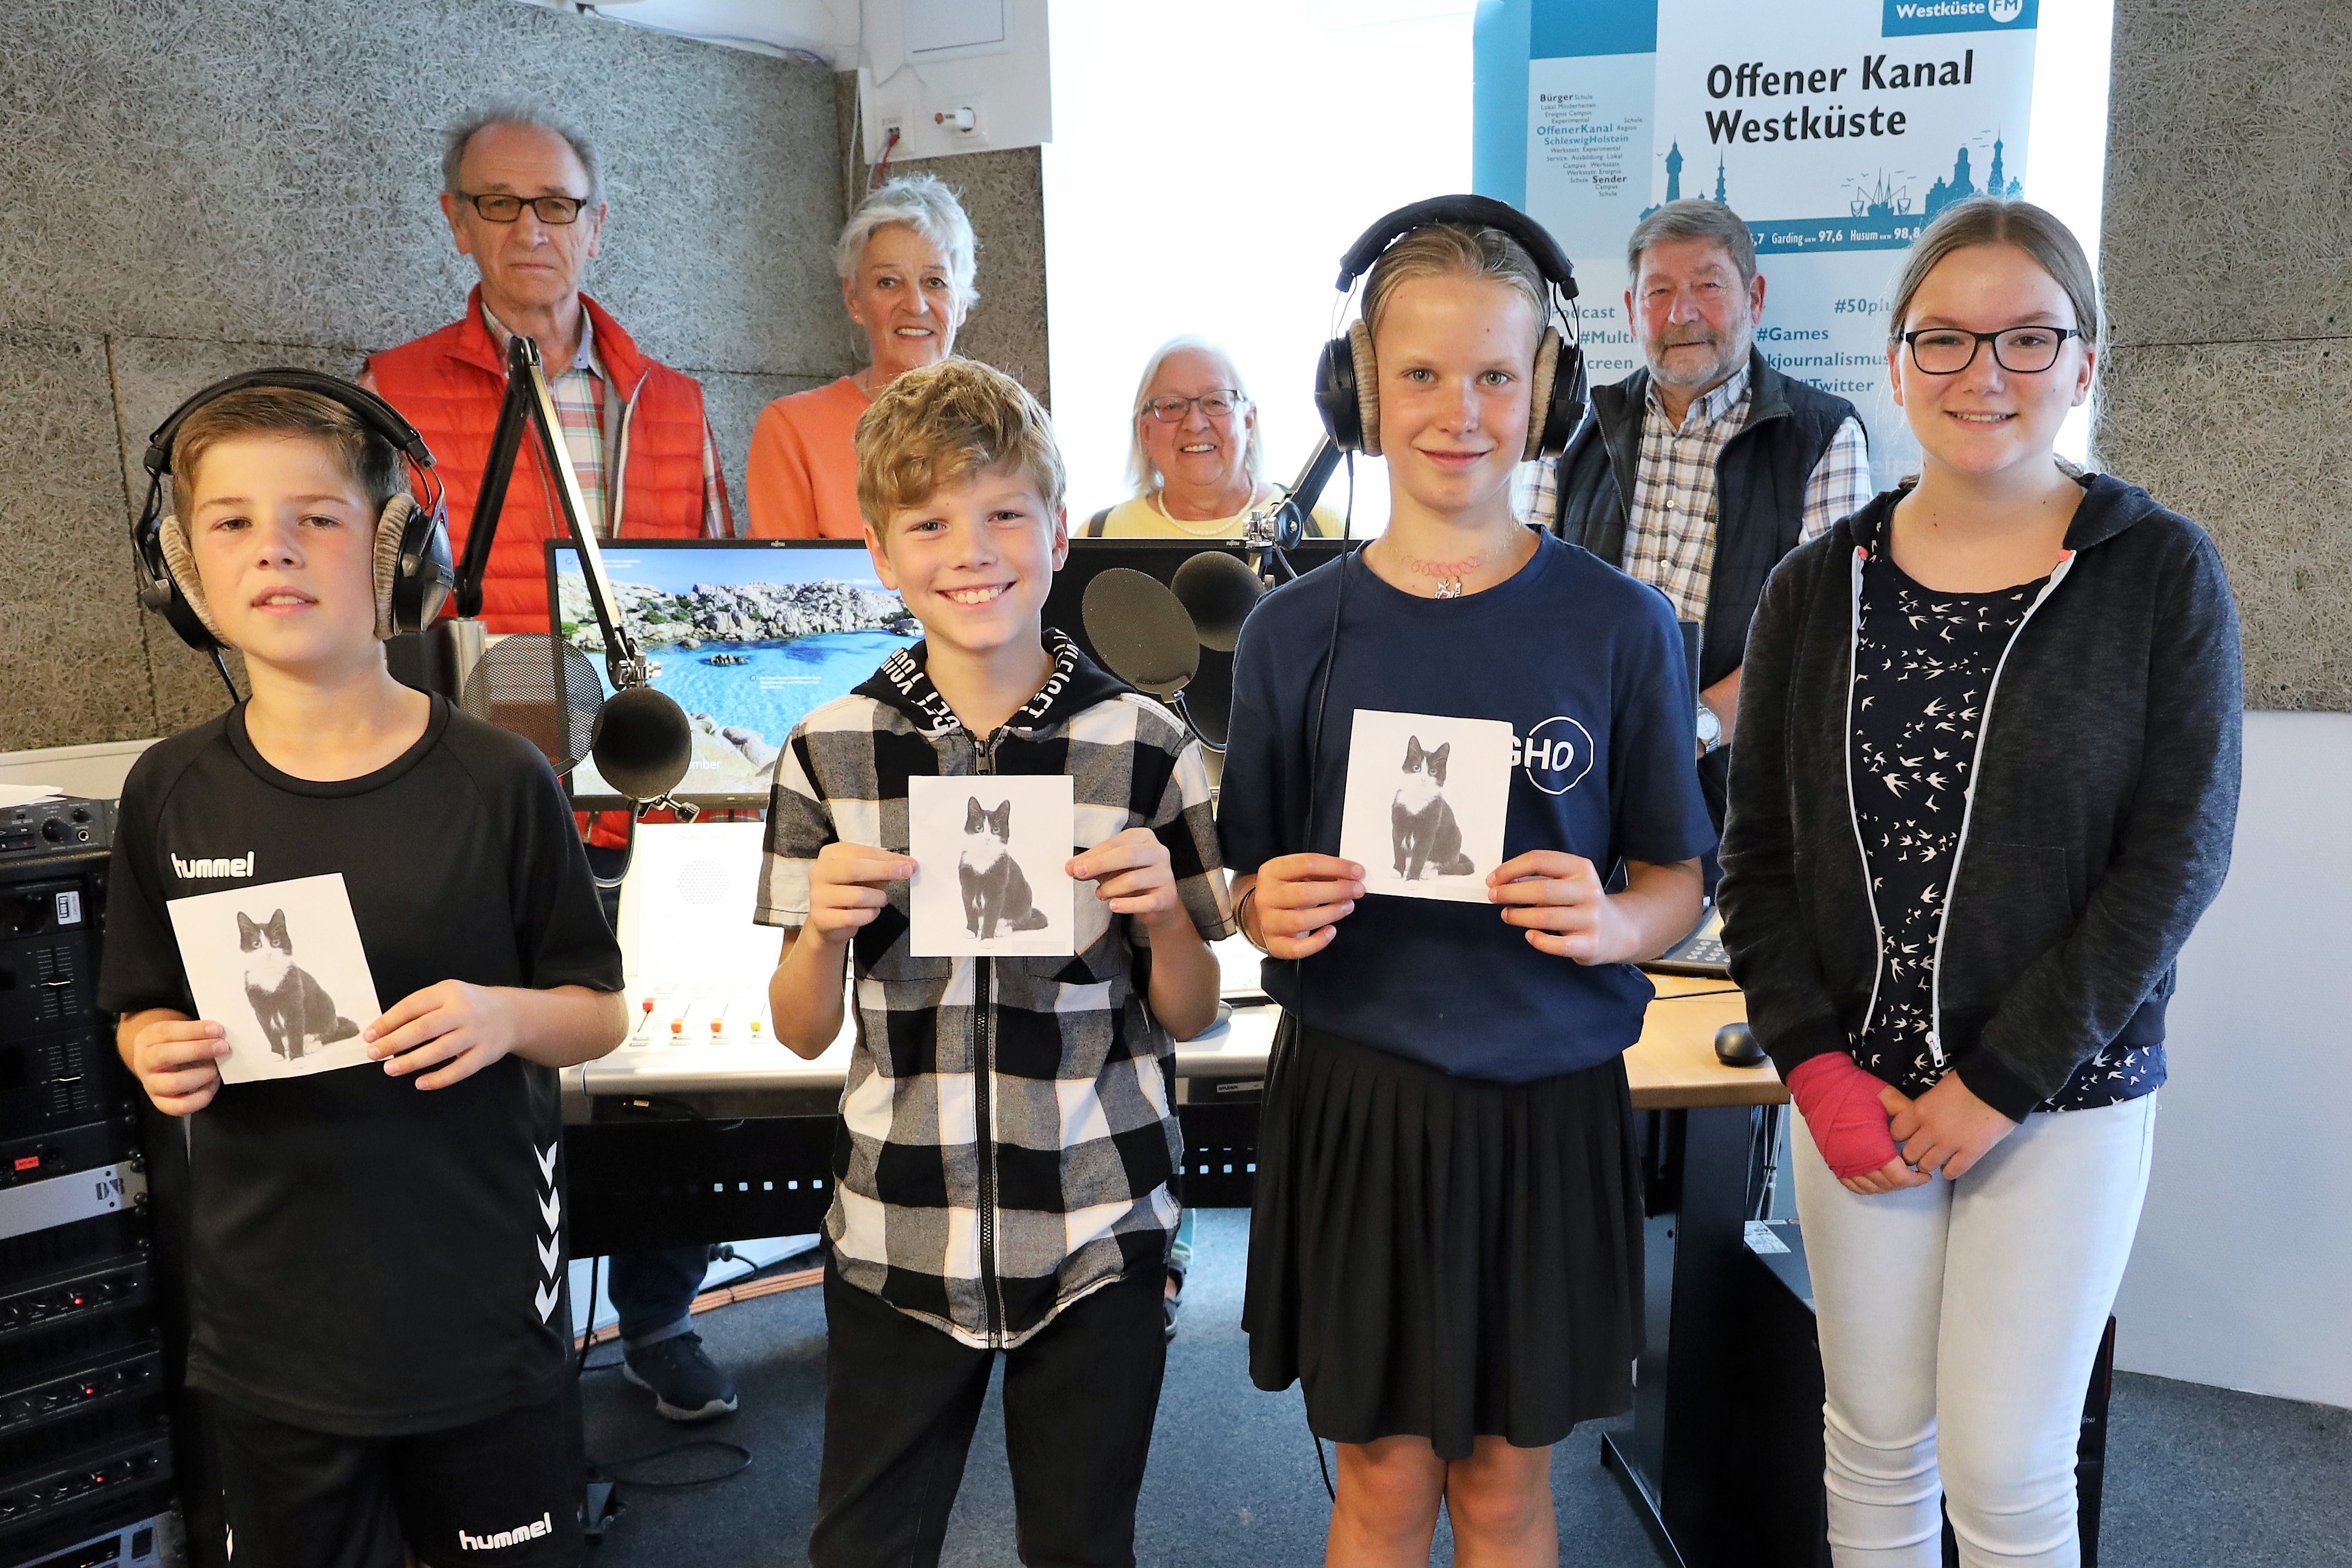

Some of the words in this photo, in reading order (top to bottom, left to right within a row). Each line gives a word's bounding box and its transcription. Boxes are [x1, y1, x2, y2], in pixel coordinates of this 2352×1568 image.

[1896, 1, 1985, 19] Westküste
[1993, 0, 2019, 11] FM
[1708, 62, 1847, 98] Offener
[1862, 49, 1973, 90] Kanal
[1540, 94, 1573, 103] Bürger
[1537, 124, 1612, 136] OffenerKanal
[1705, 106, 1906, 144] Westküste
[1544, 135, 1628, 146] SchleswigHolstein
[1592, 175, 1627, 183] Sender
[1771, 232, 1803, 246] Garding
[1818, 229, 1843, 243] 97,6
[1850, 229, 1878, 241] Husum
[1894, 227, 1920, 240] 98,8
[1757, 327, 1829, 341] #Games
[171, 851, 254, 879] hummel
[459, 1512, 553, 1550] hummel
